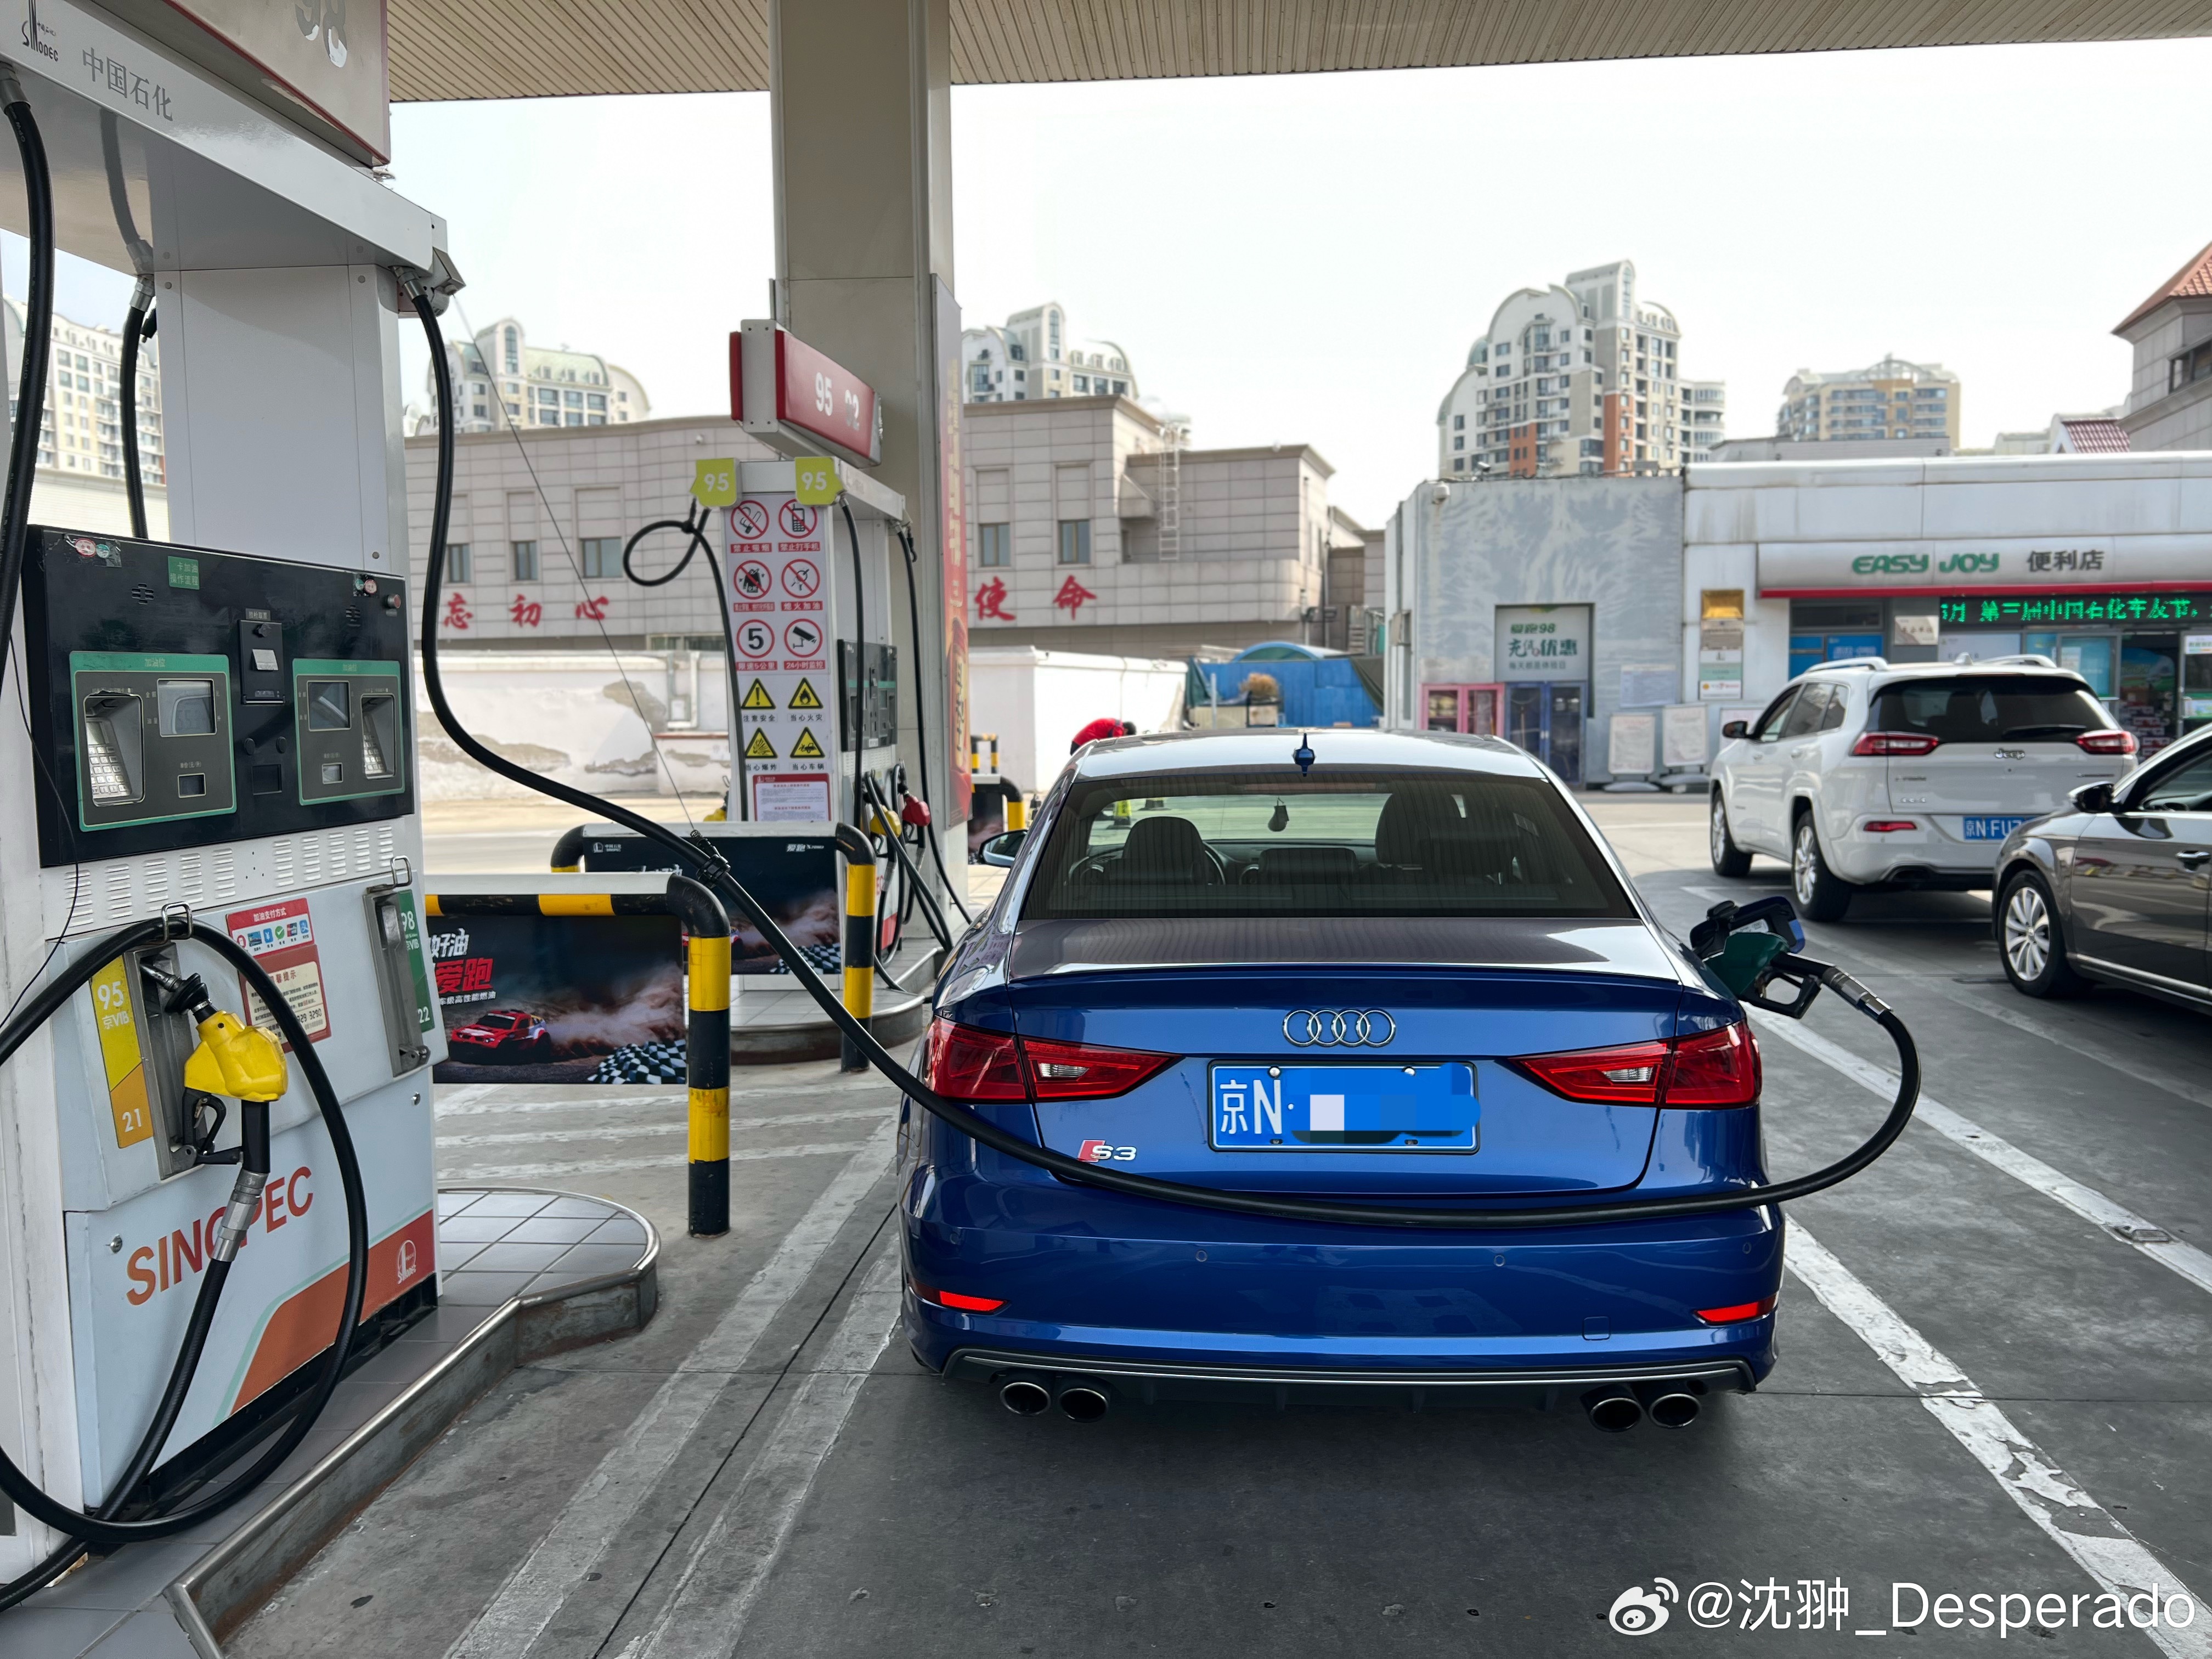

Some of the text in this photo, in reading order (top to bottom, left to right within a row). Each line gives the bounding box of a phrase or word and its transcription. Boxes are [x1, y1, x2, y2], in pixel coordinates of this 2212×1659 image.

[82, 47, 173, 122] 中国石化
[815, 372, 833, 416] 95
[704, 473, 729, 492] 95
[802, 472, 827, 491] 95
[733, 544, 770, 552] 禁止吸烟
[780, 542, 819, 551] 禁止打手机
[1852, 550, 2104, 574] EASY JOY 便利店
[974, 575, 1097, 620] 使命
[784, 602, 821, 612] 熄火加油
[748, 628, 764, 650] 5
[738, 662, 776, 670] 限速5公里
[786, 661, 823, 669] 24小时监控
[743, 714, 776, 723] 注意安全
[791, 714, 823, 722] 当心火灾
[1994, 748, 2026, 760] Jeep
[746, 763, 777, 772] 当心爆炸
[792, 763, 825, 771] 当心车辆
[253, 907, 287, 922] 加油支付方式
[401, 911, 415, 932] 98
[436, 958, 493, 994] 爱跑
[97, 980, 125, 1010] 95
[417, 1006, 431, 1024] 22
[122, 1108, 142, 1133] 21
[1090, 1145, 1137, 1161] S3
